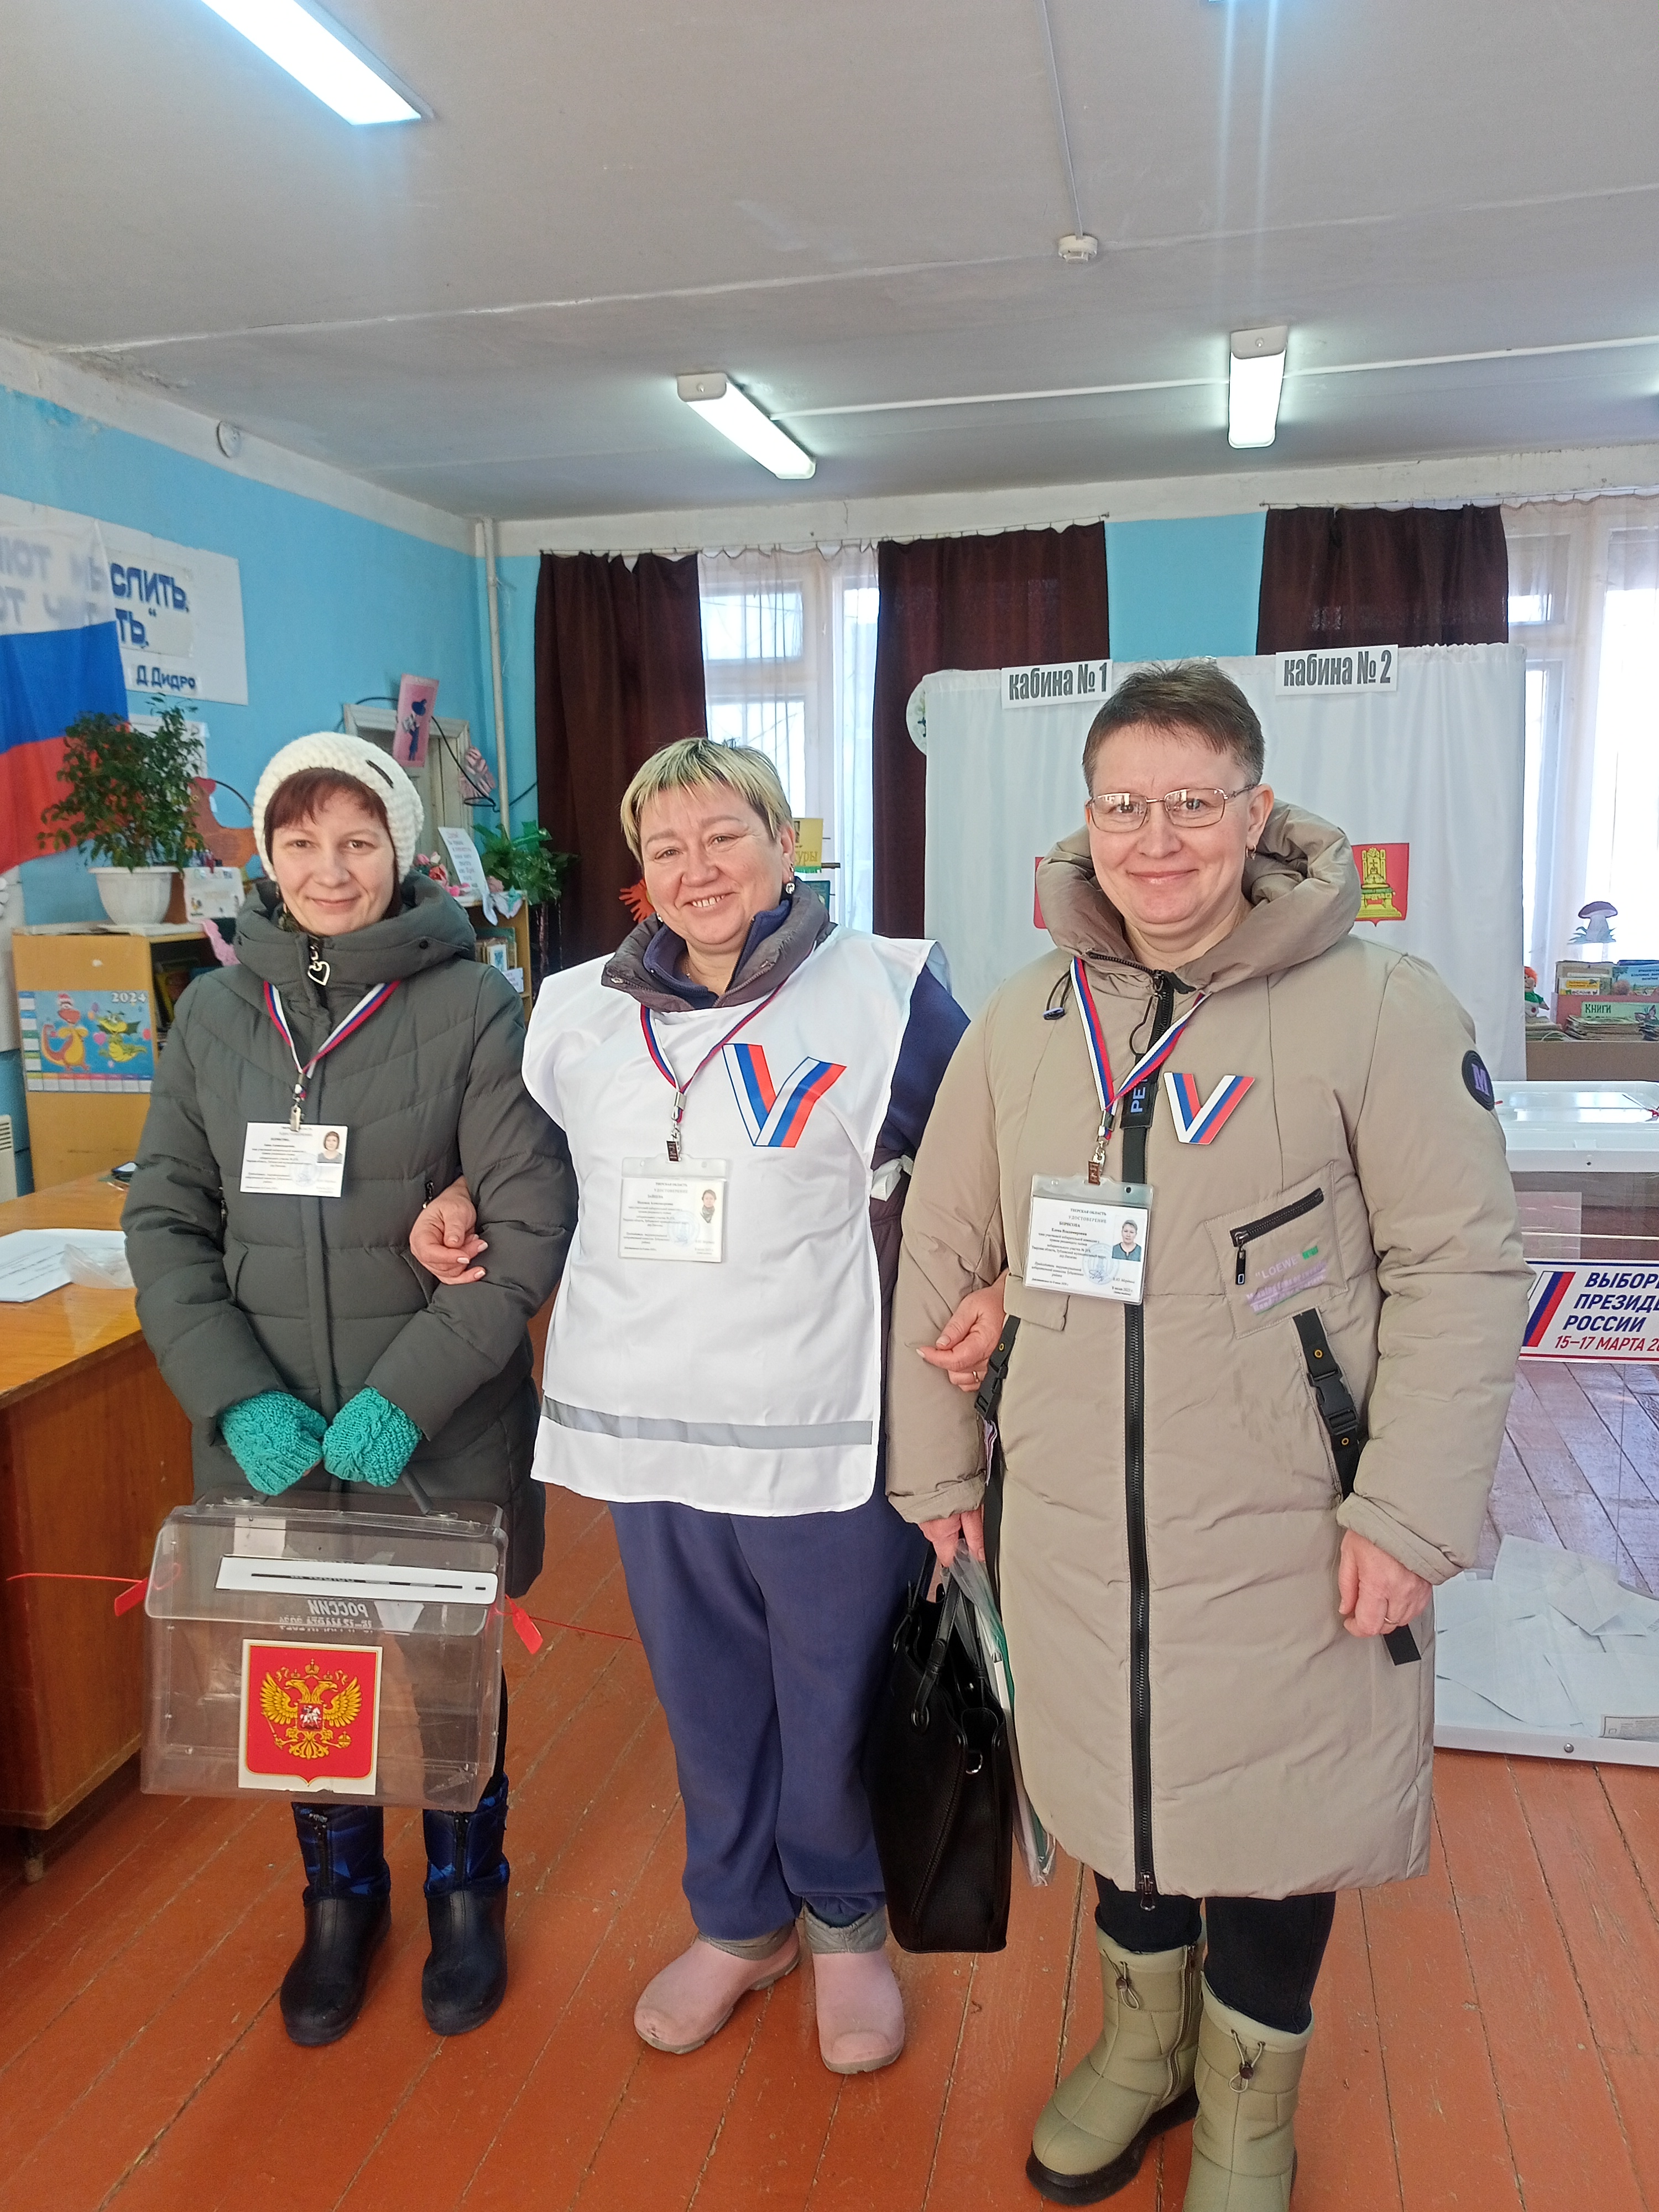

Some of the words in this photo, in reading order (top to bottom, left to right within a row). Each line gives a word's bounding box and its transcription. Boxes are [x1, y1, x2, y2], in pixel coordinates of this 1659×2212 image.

[1284, 653, 1353, 686] кабина
[1357, 650, 1376, 685] №
[1380, 649, 1392, 684] 2
[1009, 667, 1073, 701] кабина
[1078, 664, 1095, 695] №
[1099, 662, 1107, 692] 1
[111, 992, 147, 1004] 2024
[1584, 1272, 1659, 1289] ВЫБОР
[1562, 1314, 1647, 1332] РОССИИ
[1595, 1337, 1645, 1352] МАРТА
[1646, 1338, 1659, 1352] 2
